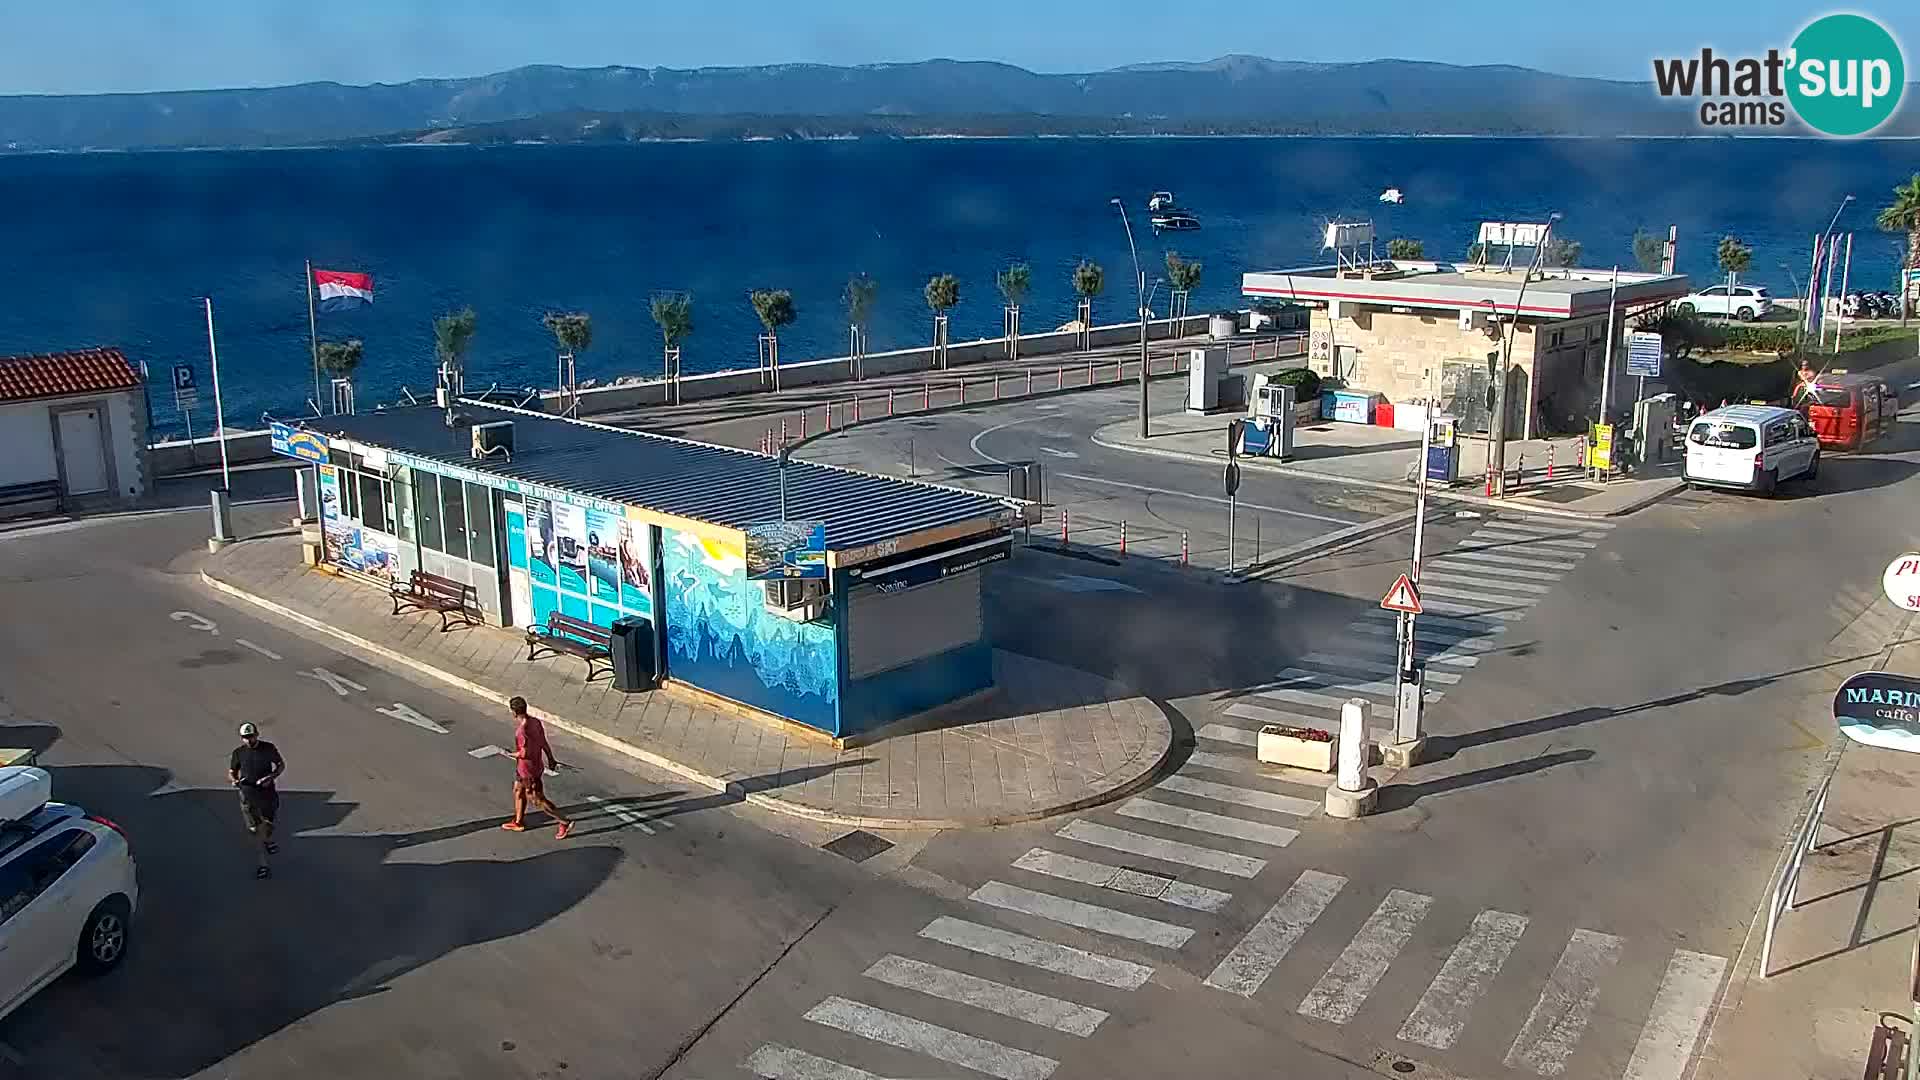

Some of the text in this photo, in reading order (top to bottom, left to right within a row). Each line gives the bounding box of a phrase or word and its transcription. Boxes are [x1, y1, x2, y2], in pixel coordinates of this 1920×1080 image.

[178, 367, 191, 387] P
[533, 486, 567, 503] STATION
[569, 495, 594, 508] TICKET
[594, 500, 622, 514] OFFICE
[1907, 595, 1920, 608] S
